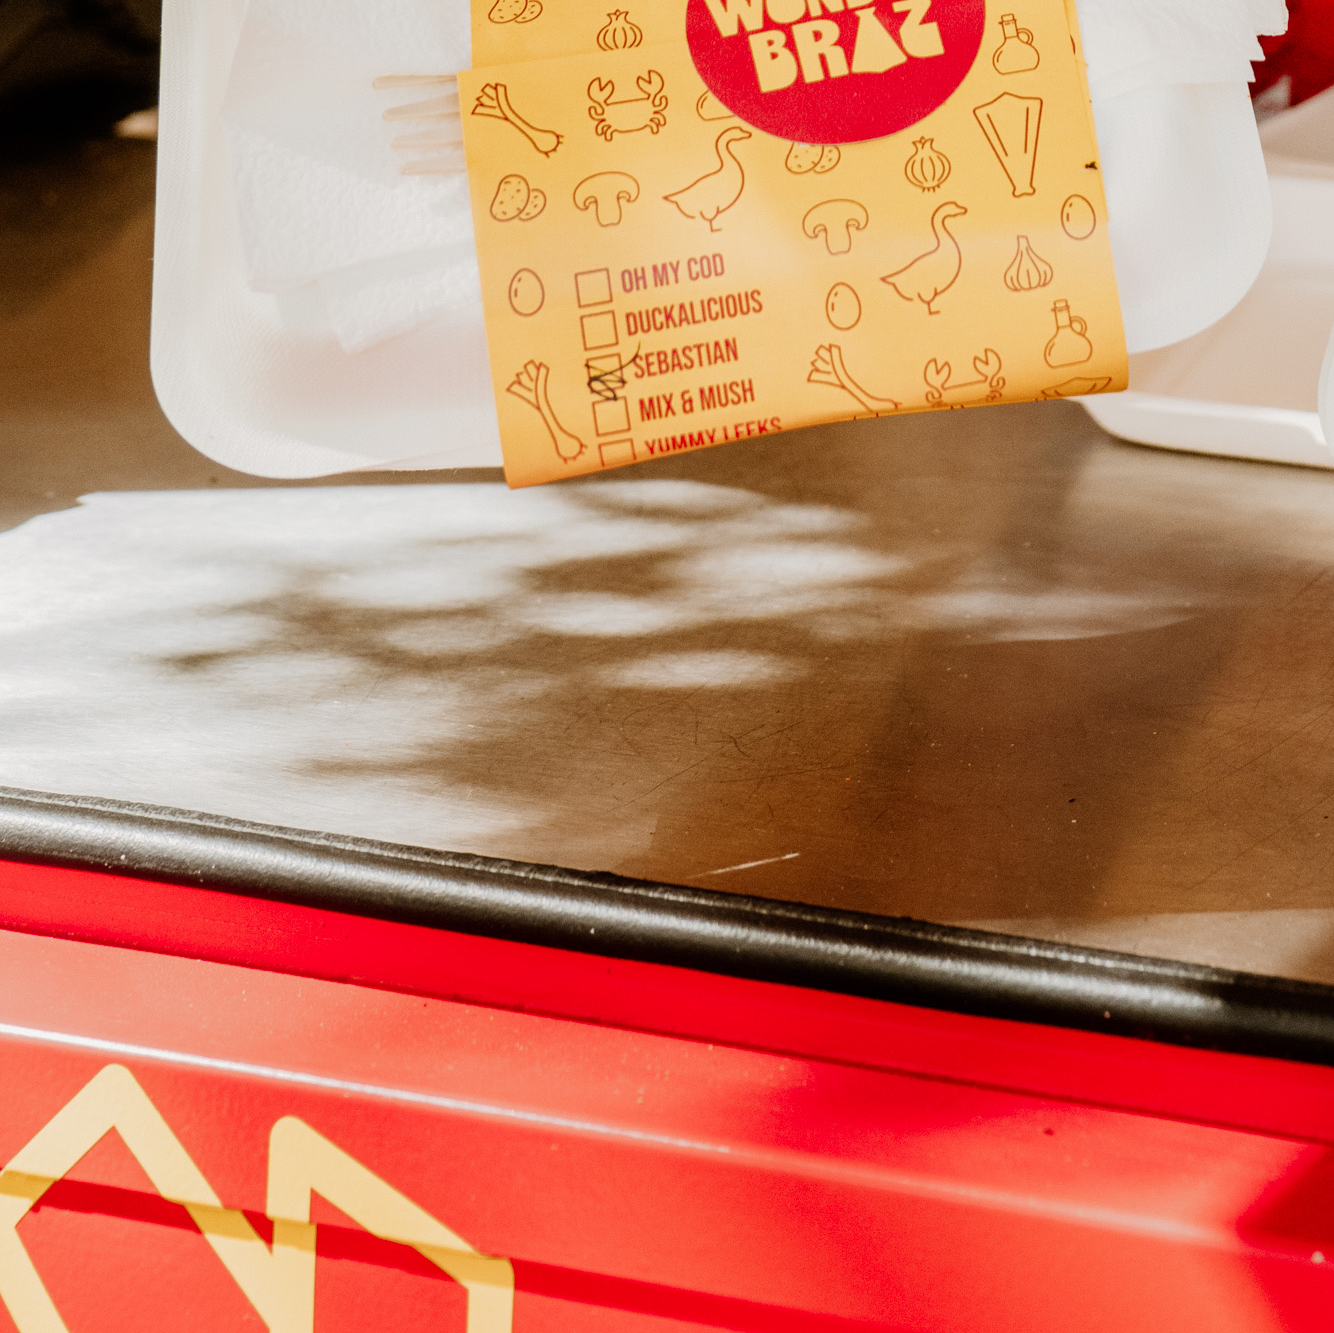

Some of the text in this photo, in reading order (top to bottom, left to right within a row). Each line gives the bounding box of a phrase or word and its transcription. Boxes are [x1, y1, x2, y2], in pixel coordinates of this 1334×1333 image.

[621, 253, 725, 292] OH MY COD
[625, 289, 763, 337] DUCKALICIOUS
[633, 337, 739, 379] SEBASTIAN
[639, 378, 755, 422] MIX & MUSH
[645, 428, 716, 454] YUMMY
